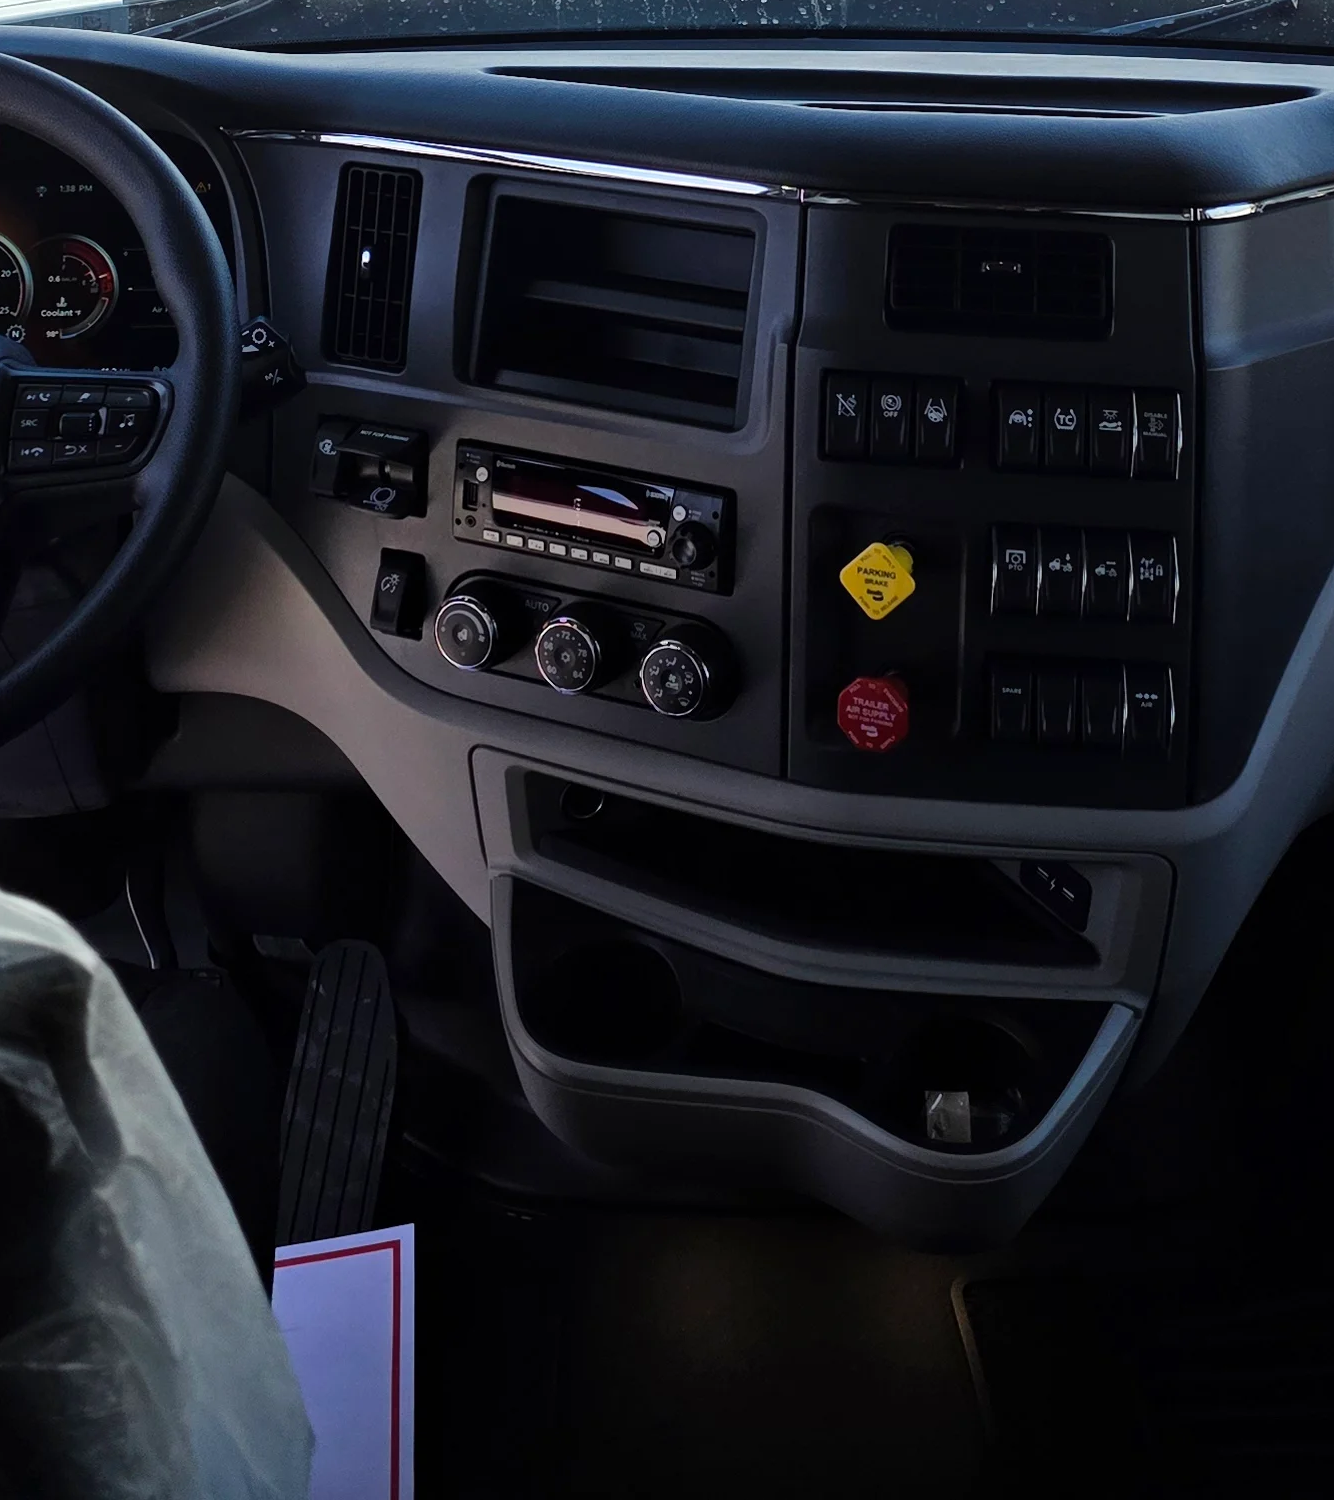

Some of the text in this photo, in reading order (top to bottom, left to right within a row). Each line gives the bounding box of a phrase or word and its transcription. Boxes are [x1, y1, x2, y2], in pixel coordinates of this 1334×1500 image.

[59, 184, 93, 193] 1:38 PM
[0, 270, 11, 278] 20
[47, 275, 61, 283] 0.6
[0, 307, 10, 315] 25
[40, 309, 73, 317] Coolant
[12, 330, 20, 338] N
[20, 418, 39, 428] SRC
[1059, 415, 1073, 424] TC
[857, 567, 896, 579] PARKING
[864, 579, 888, 587] BRAKE
[524, 599, 550, 613] AUTO
[560, 631, 572, 641] 72
[630, 631, 648, 641] MAX
[1002, 687, 1022, 695] SPARE
[853, 696, 889, 711] TRAILER
[846, 705, 897, 722] AIR SUPPLY
